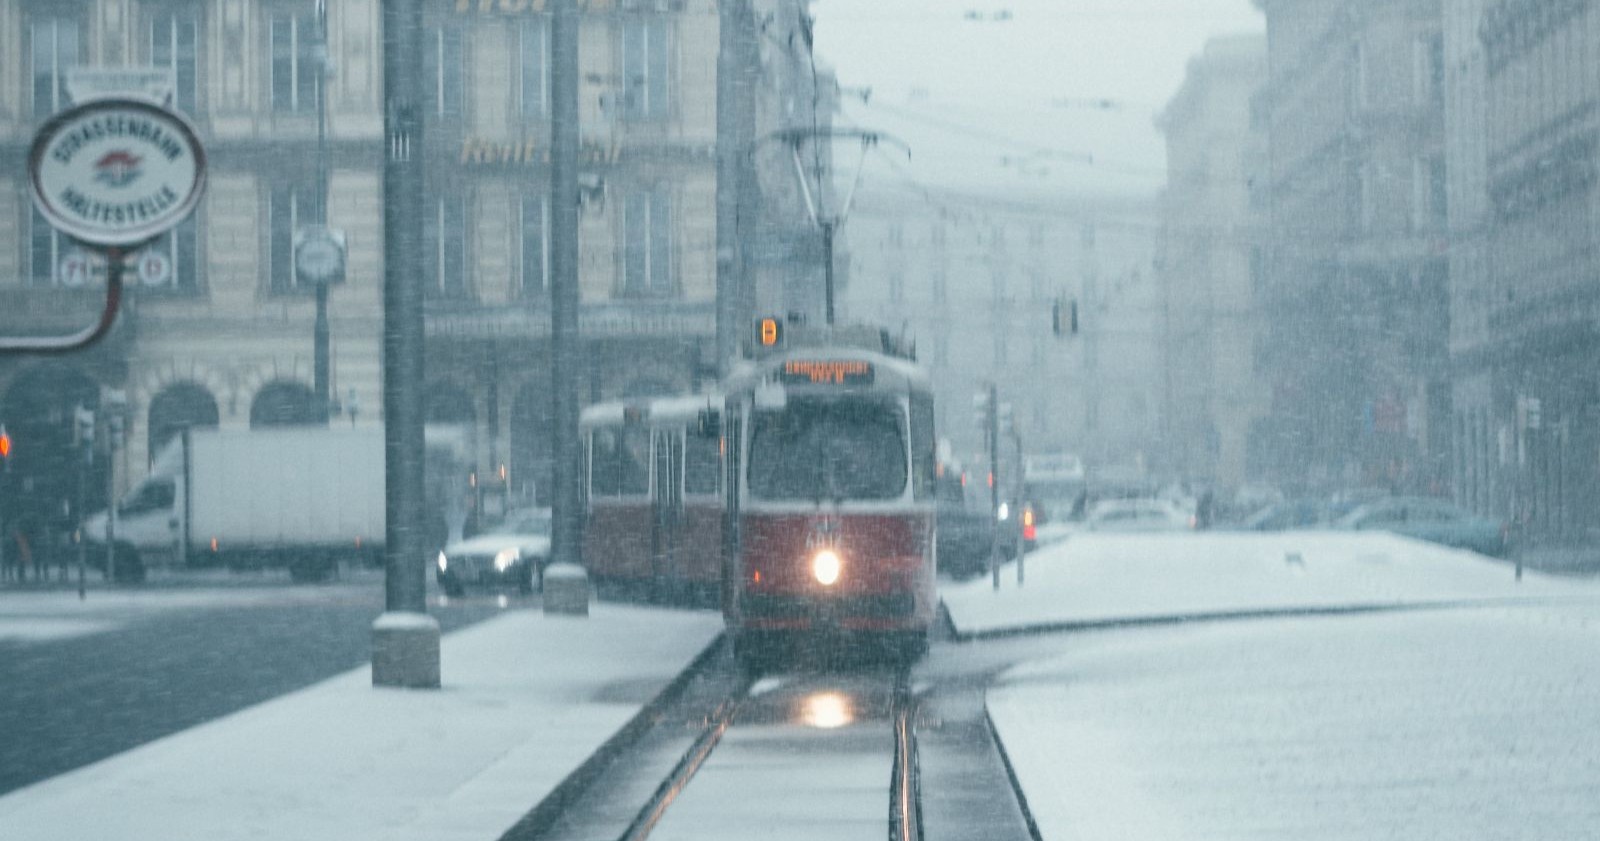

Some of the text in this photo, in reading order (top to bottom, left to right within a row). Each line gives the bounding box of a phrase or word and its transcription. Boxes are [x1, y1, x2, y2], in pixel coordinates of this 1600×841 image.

[53, 115, 184, 164] STRASSENBAHN
[60, 184, 178, 224] HALTESTELLE
[762, 318, 777, 345] D
